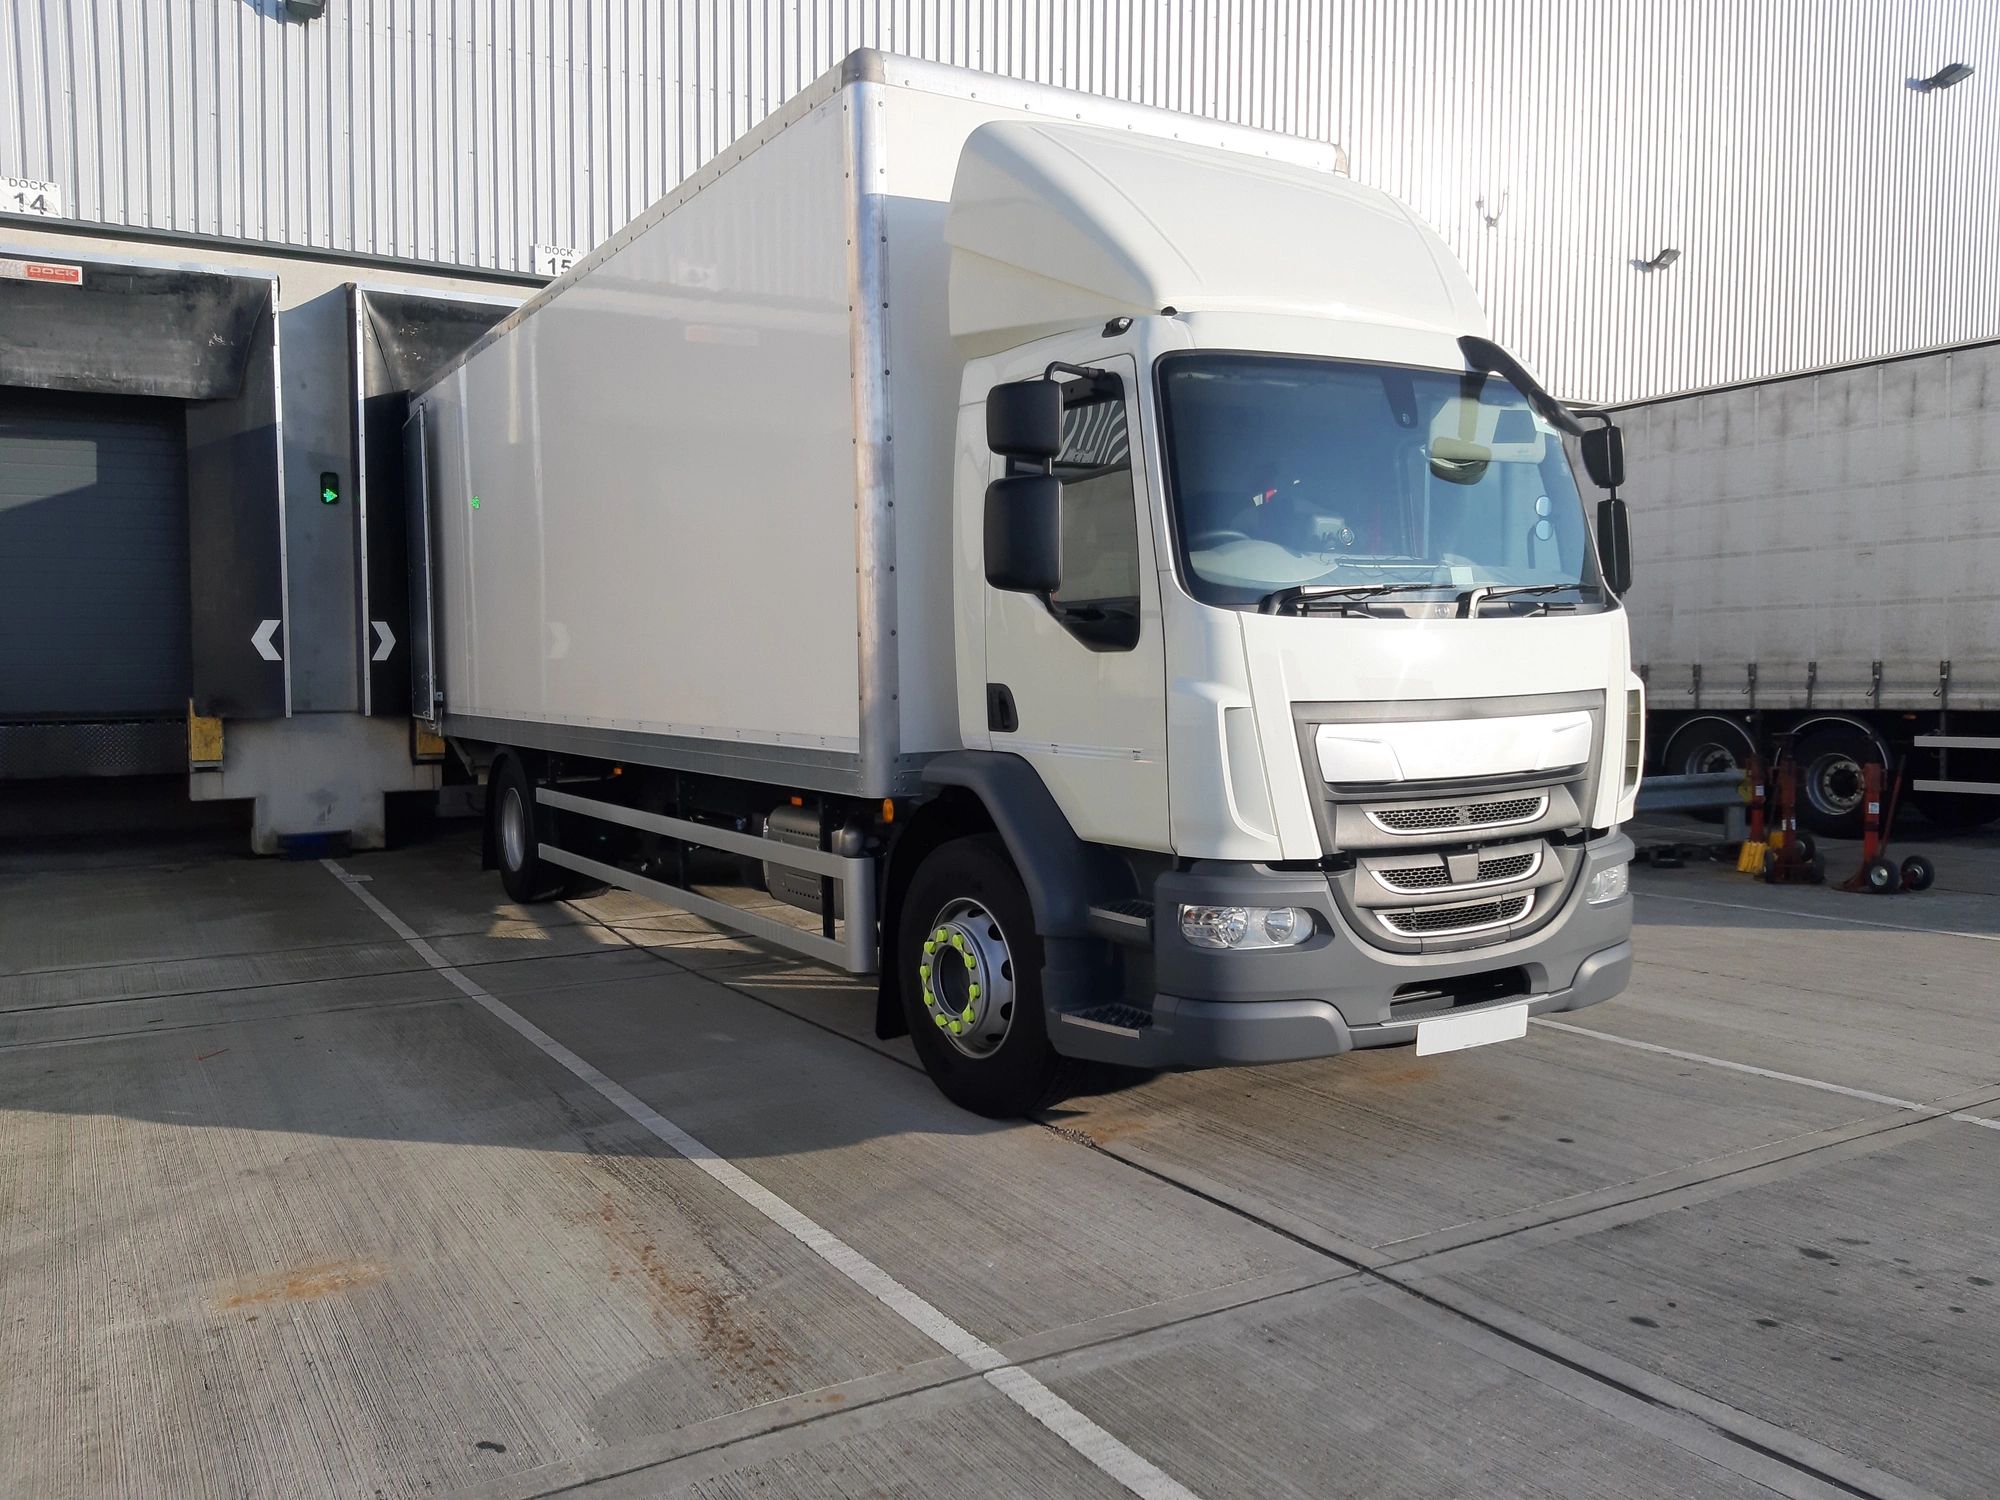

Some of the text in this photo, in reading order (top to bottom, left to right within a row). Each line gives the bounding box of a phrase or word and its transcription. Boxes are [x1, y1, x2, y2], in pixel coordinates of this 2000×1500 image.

[9, 178, 48, 192] DOCK
[14, 192, 47, 215] 14
[545, 246, 573, 257] DOCK
[548, 257, 572, 275] 15
